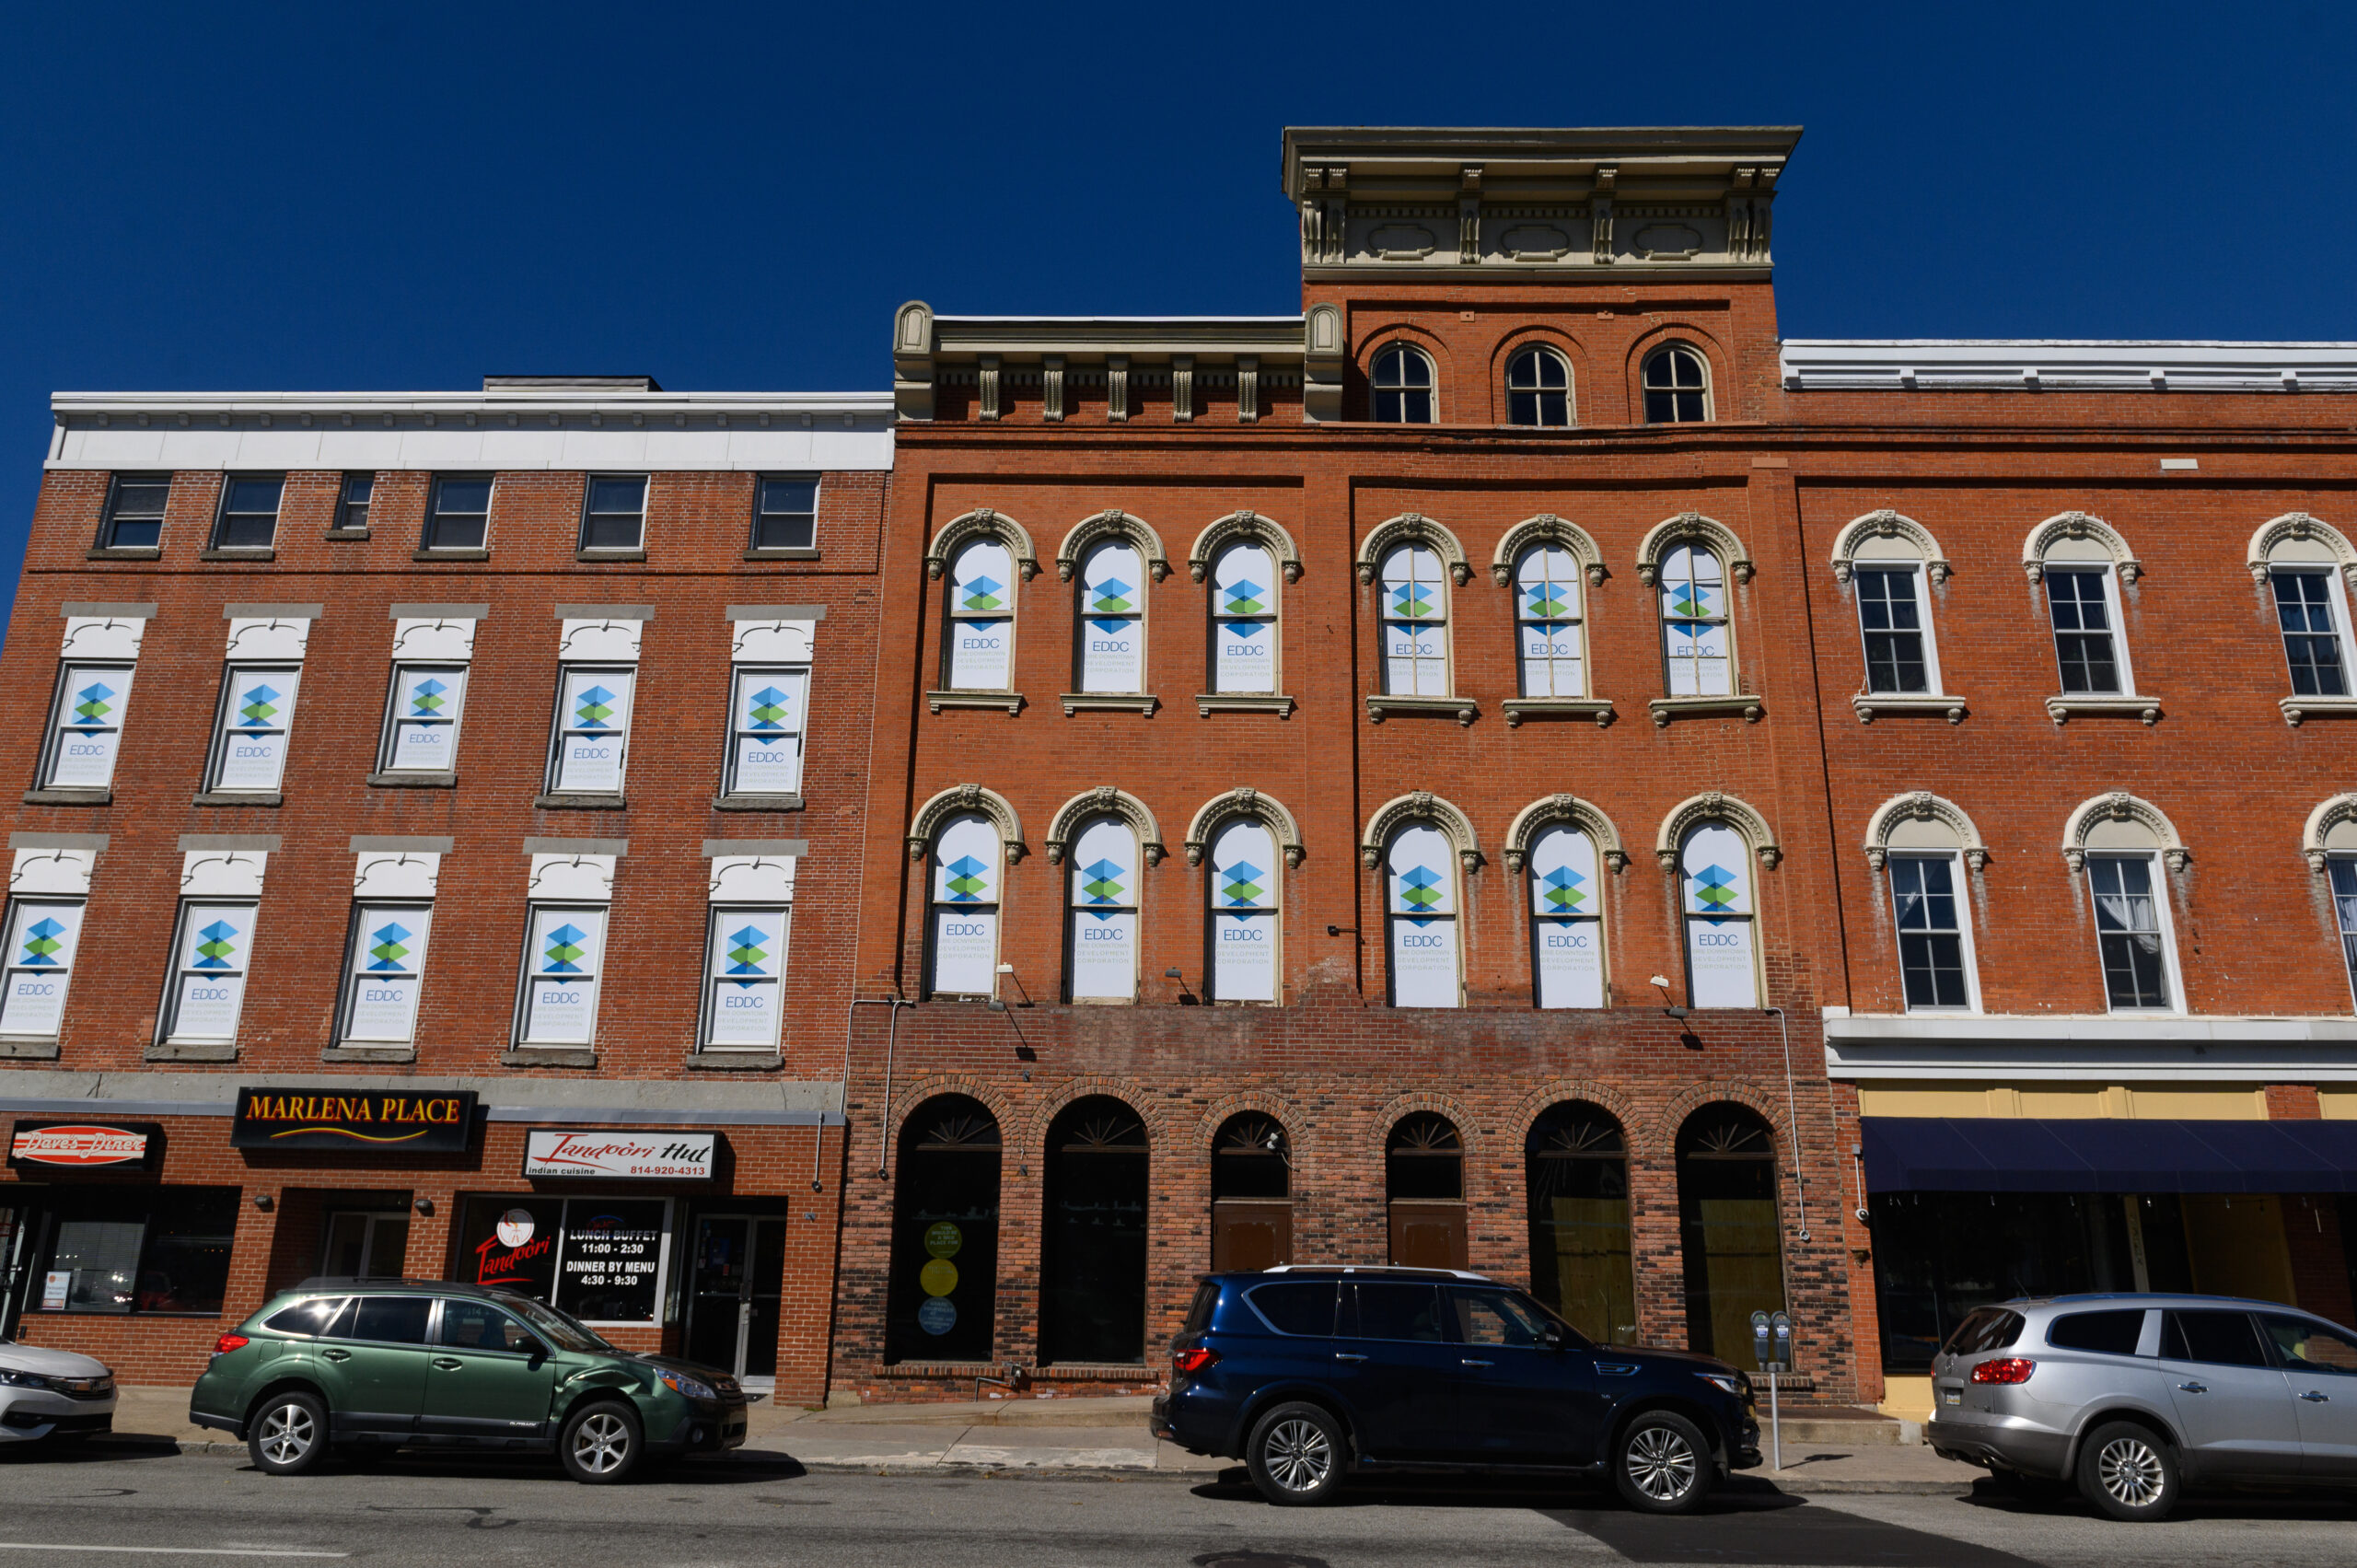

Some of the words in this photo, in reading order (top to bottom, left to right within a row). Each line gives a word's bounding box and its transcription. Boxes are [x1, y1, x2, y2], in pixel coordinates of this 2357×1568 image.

[963, 638, 1000, 648] EDDC
[1093, 641, 1130, 652] EDDC
[1227, 645, 1264, 656] EDDC
[1396, 645, 1433, 655] EDDC
[1531, 644, 1568, 655] EDDC
[1678, 646, 1714, 656] EDDC
[410, 734, 441, 743] EDDC
[70, 745, 104, 755] EDDC
[236, 747, 272, 757] EDDC
[574, 748, 610, 759] EDDC
[749, 752, 784, 762] EDDC
[946, 923, 985, 935] EDDC
[1085, 929, 1123, 940] EDDC
[1224, 929, 1263, 941] EDDC
[1404, 935, 1443, 947] EDDC
[1548, 935, 1587, 947] EDDC
[1699, 935, 1738, 947] EDDC
[17, 984, 54, 995] EDDC
[192, 988, 228, 1000] EDDC
[366, 990, 403, 1001] EDDC
[542, 993, 580, 1004] EDDC
[726, 996, 763, 1008] EDDC
[246, 1096, 372, 1121] MARLENA
[380, 1098, 459, 1123] PLACE
[15, 1132, 78, 1158] Dave's
[79, 1132, 145, 1158] Diner
[660, 1143, 712, 1163] Hut
[528, 1167, 557, 1175] indian
[631, 1166, 705, 1175] 814-920-4313
[570, 1230, 610, 1240] LUNCH
[613, 1230, 657, 1240] BUFFET
[581, 1243, 610, 1253] 11:00
[621, 1244, 644, 1253] 2:30
[566, 1260, 606, 1272] DINNER
[609, 1261, 622, 1272] BY
[625, 1261, 655, 1272] MENU
[581, 1275, 605, 1285] 4:30
[614, 1275, 638, 1285] 9:30
